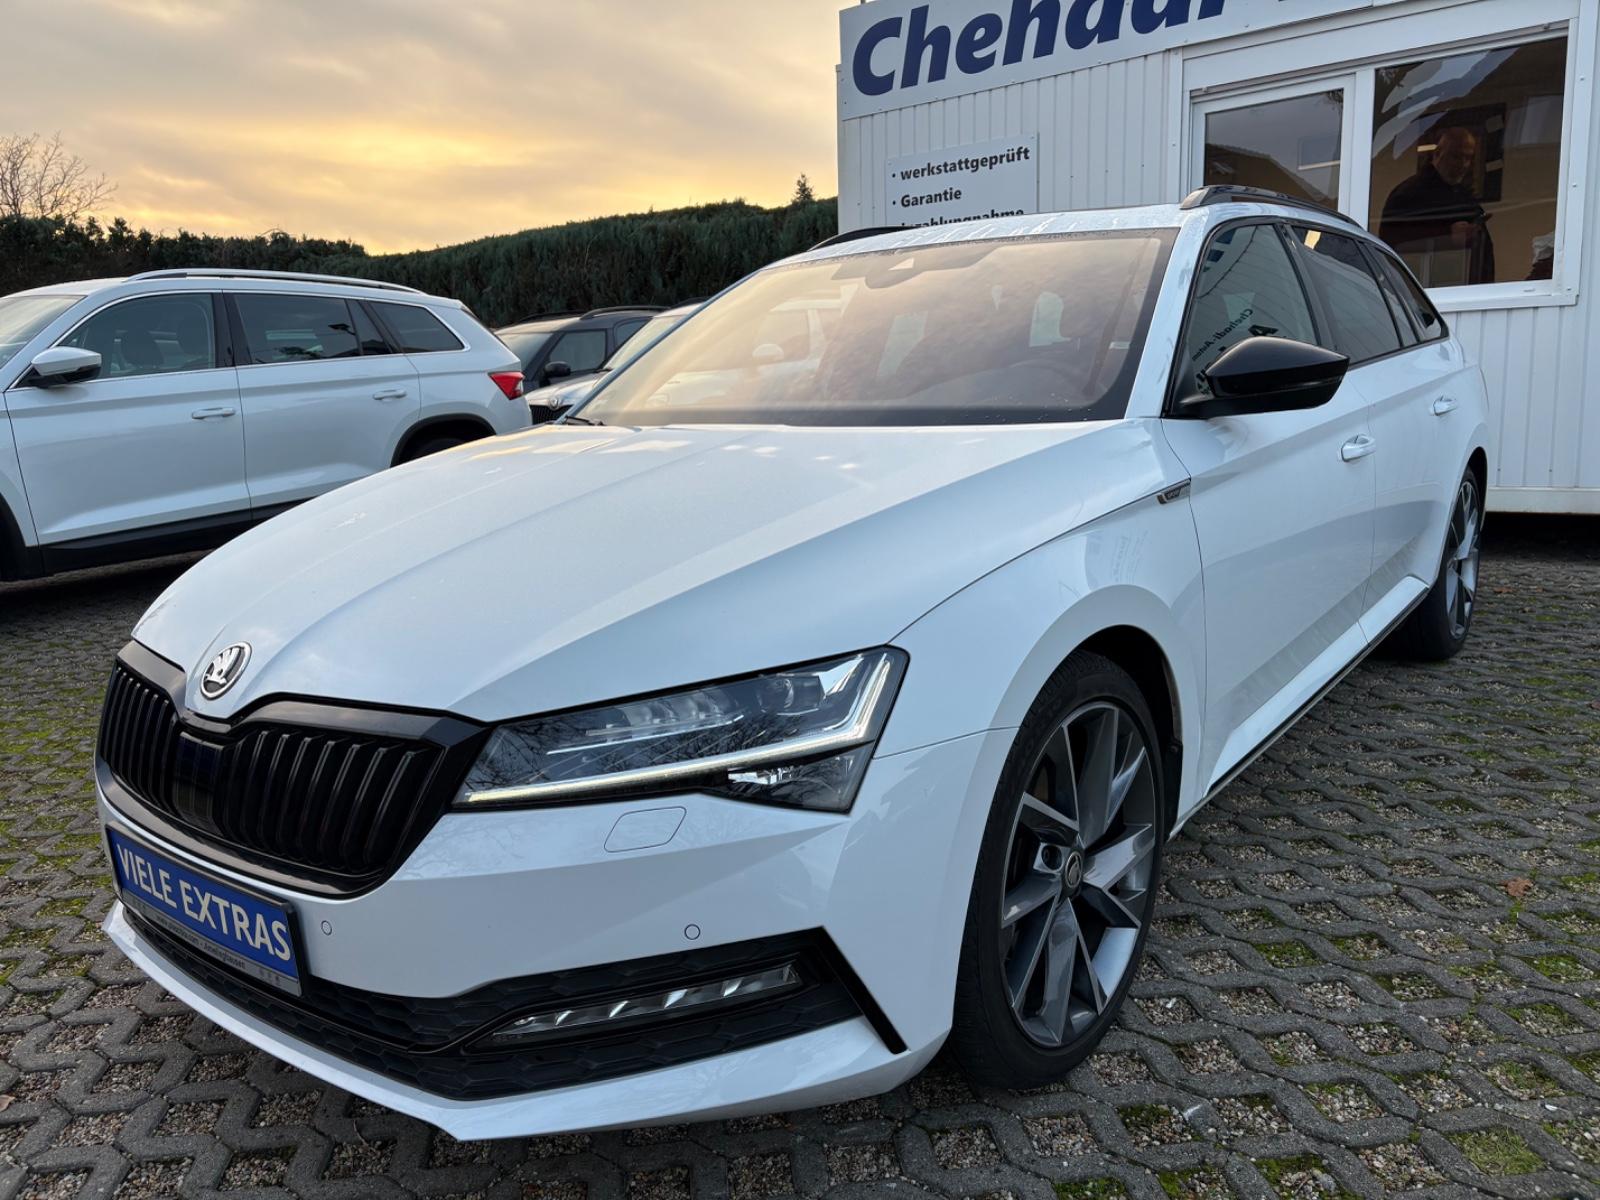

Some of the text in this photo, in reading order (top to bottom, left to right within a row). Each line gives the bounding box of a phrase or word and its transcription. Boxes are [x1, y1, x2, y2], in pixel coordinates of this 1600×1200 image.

[900, 146, 1030, 180] werkstattgeprüft
[900, 187, 962, 208] Garantie
[116, 843, 177, 909] VIELE
[179, 879, 291, 961] EXTRAS
